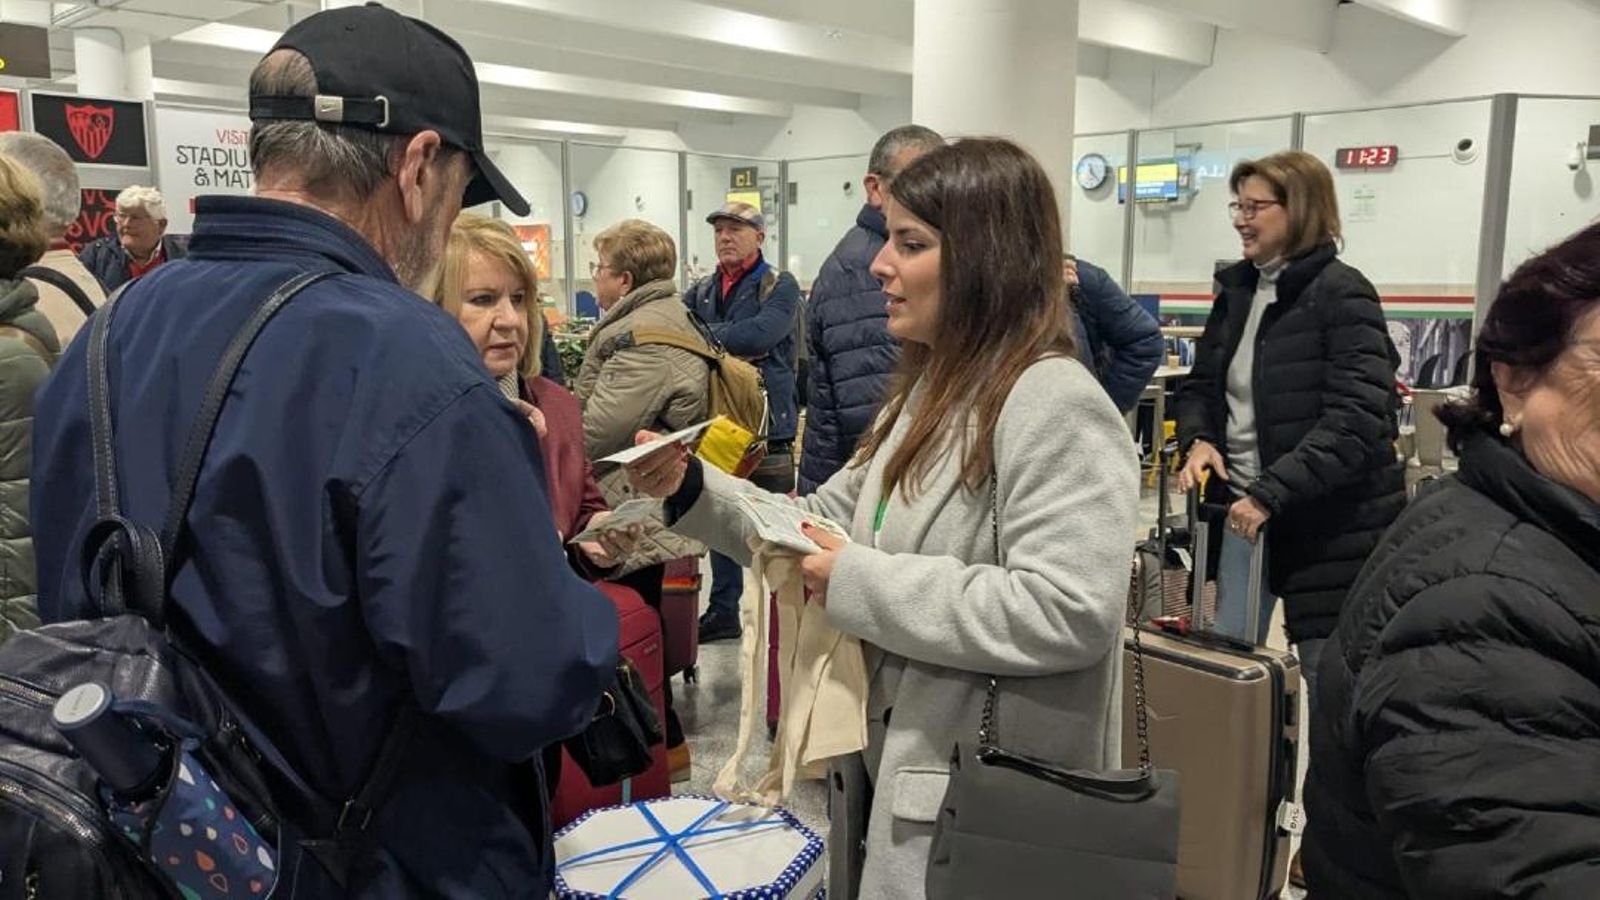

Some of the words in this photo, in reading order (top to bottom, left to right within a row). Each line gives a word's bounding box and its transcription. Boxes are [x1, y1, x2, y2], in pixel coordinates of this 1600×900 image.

[176, 145, 248, 168] STADIU
[1346, 147, 1391, 165] 11:23
[194, 167, 210, 186] &
[213, 168, 253, 189] MAT
